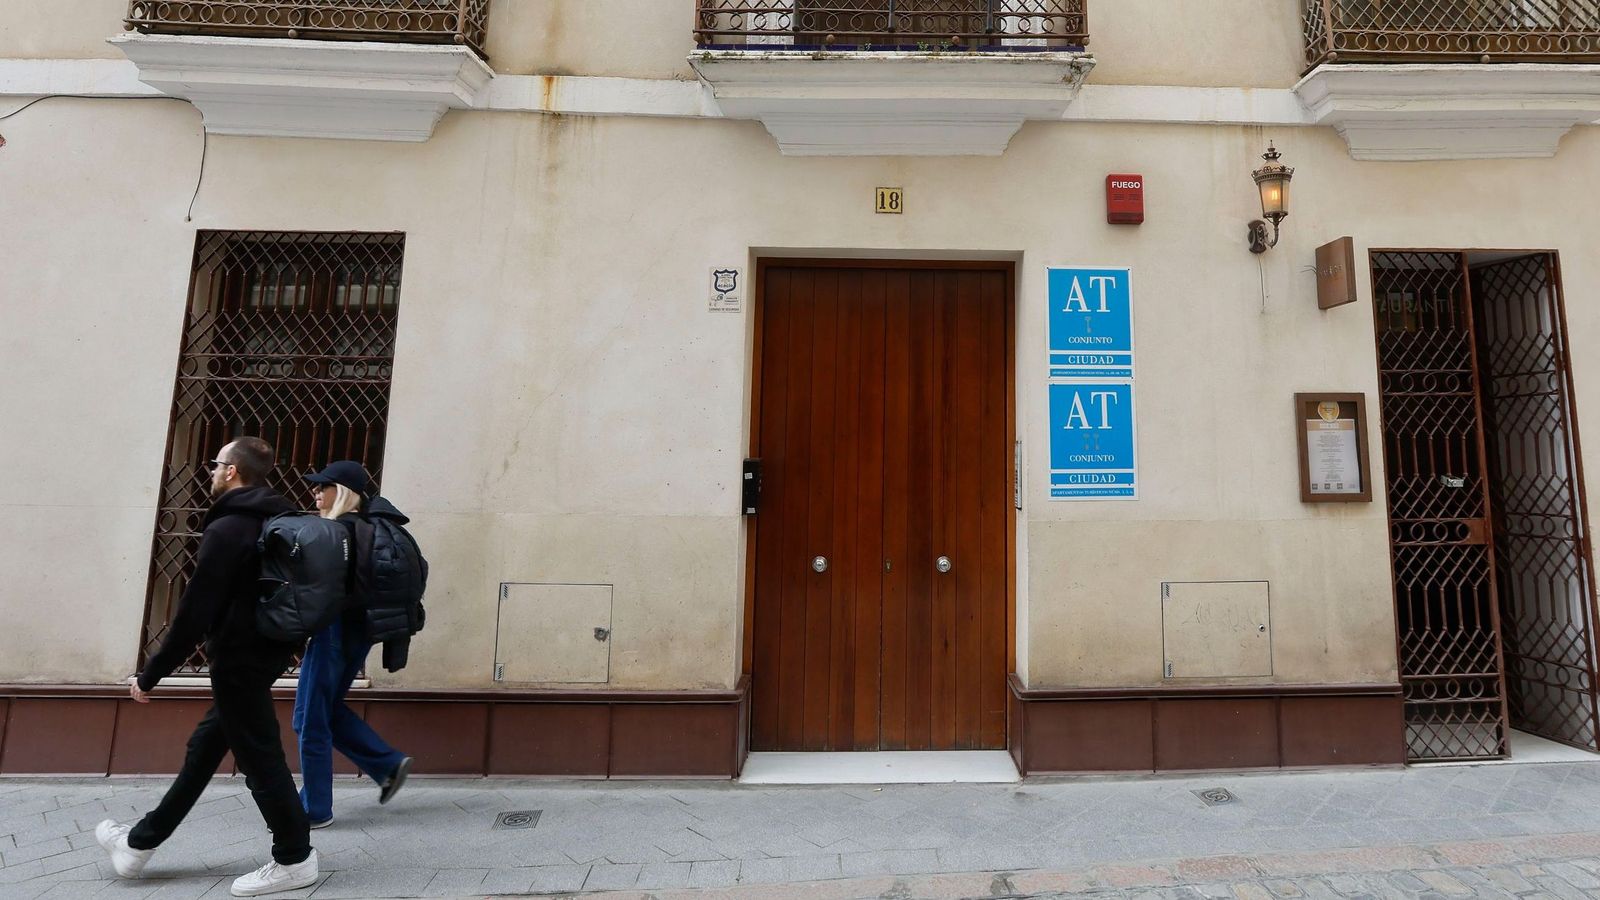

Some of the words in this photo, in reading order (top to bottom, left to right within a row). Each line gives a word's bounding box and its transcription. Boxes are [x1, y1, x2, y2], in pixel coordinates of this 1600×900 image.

[1111, 181, 1141, 189] FUEGO
[879, 191, 900, 210] 18
[1062, 275, 1116, 312] AT
[1068, 336, 1113, 344] CONJUNTO
[1068, 355, 1114, 364] CIUDAD
[1063, 391, 1118, 429] AT
[1069, 454, 1115, 463] CONJUNTO
[1069, 474, 1116, 483] CIUDAD
